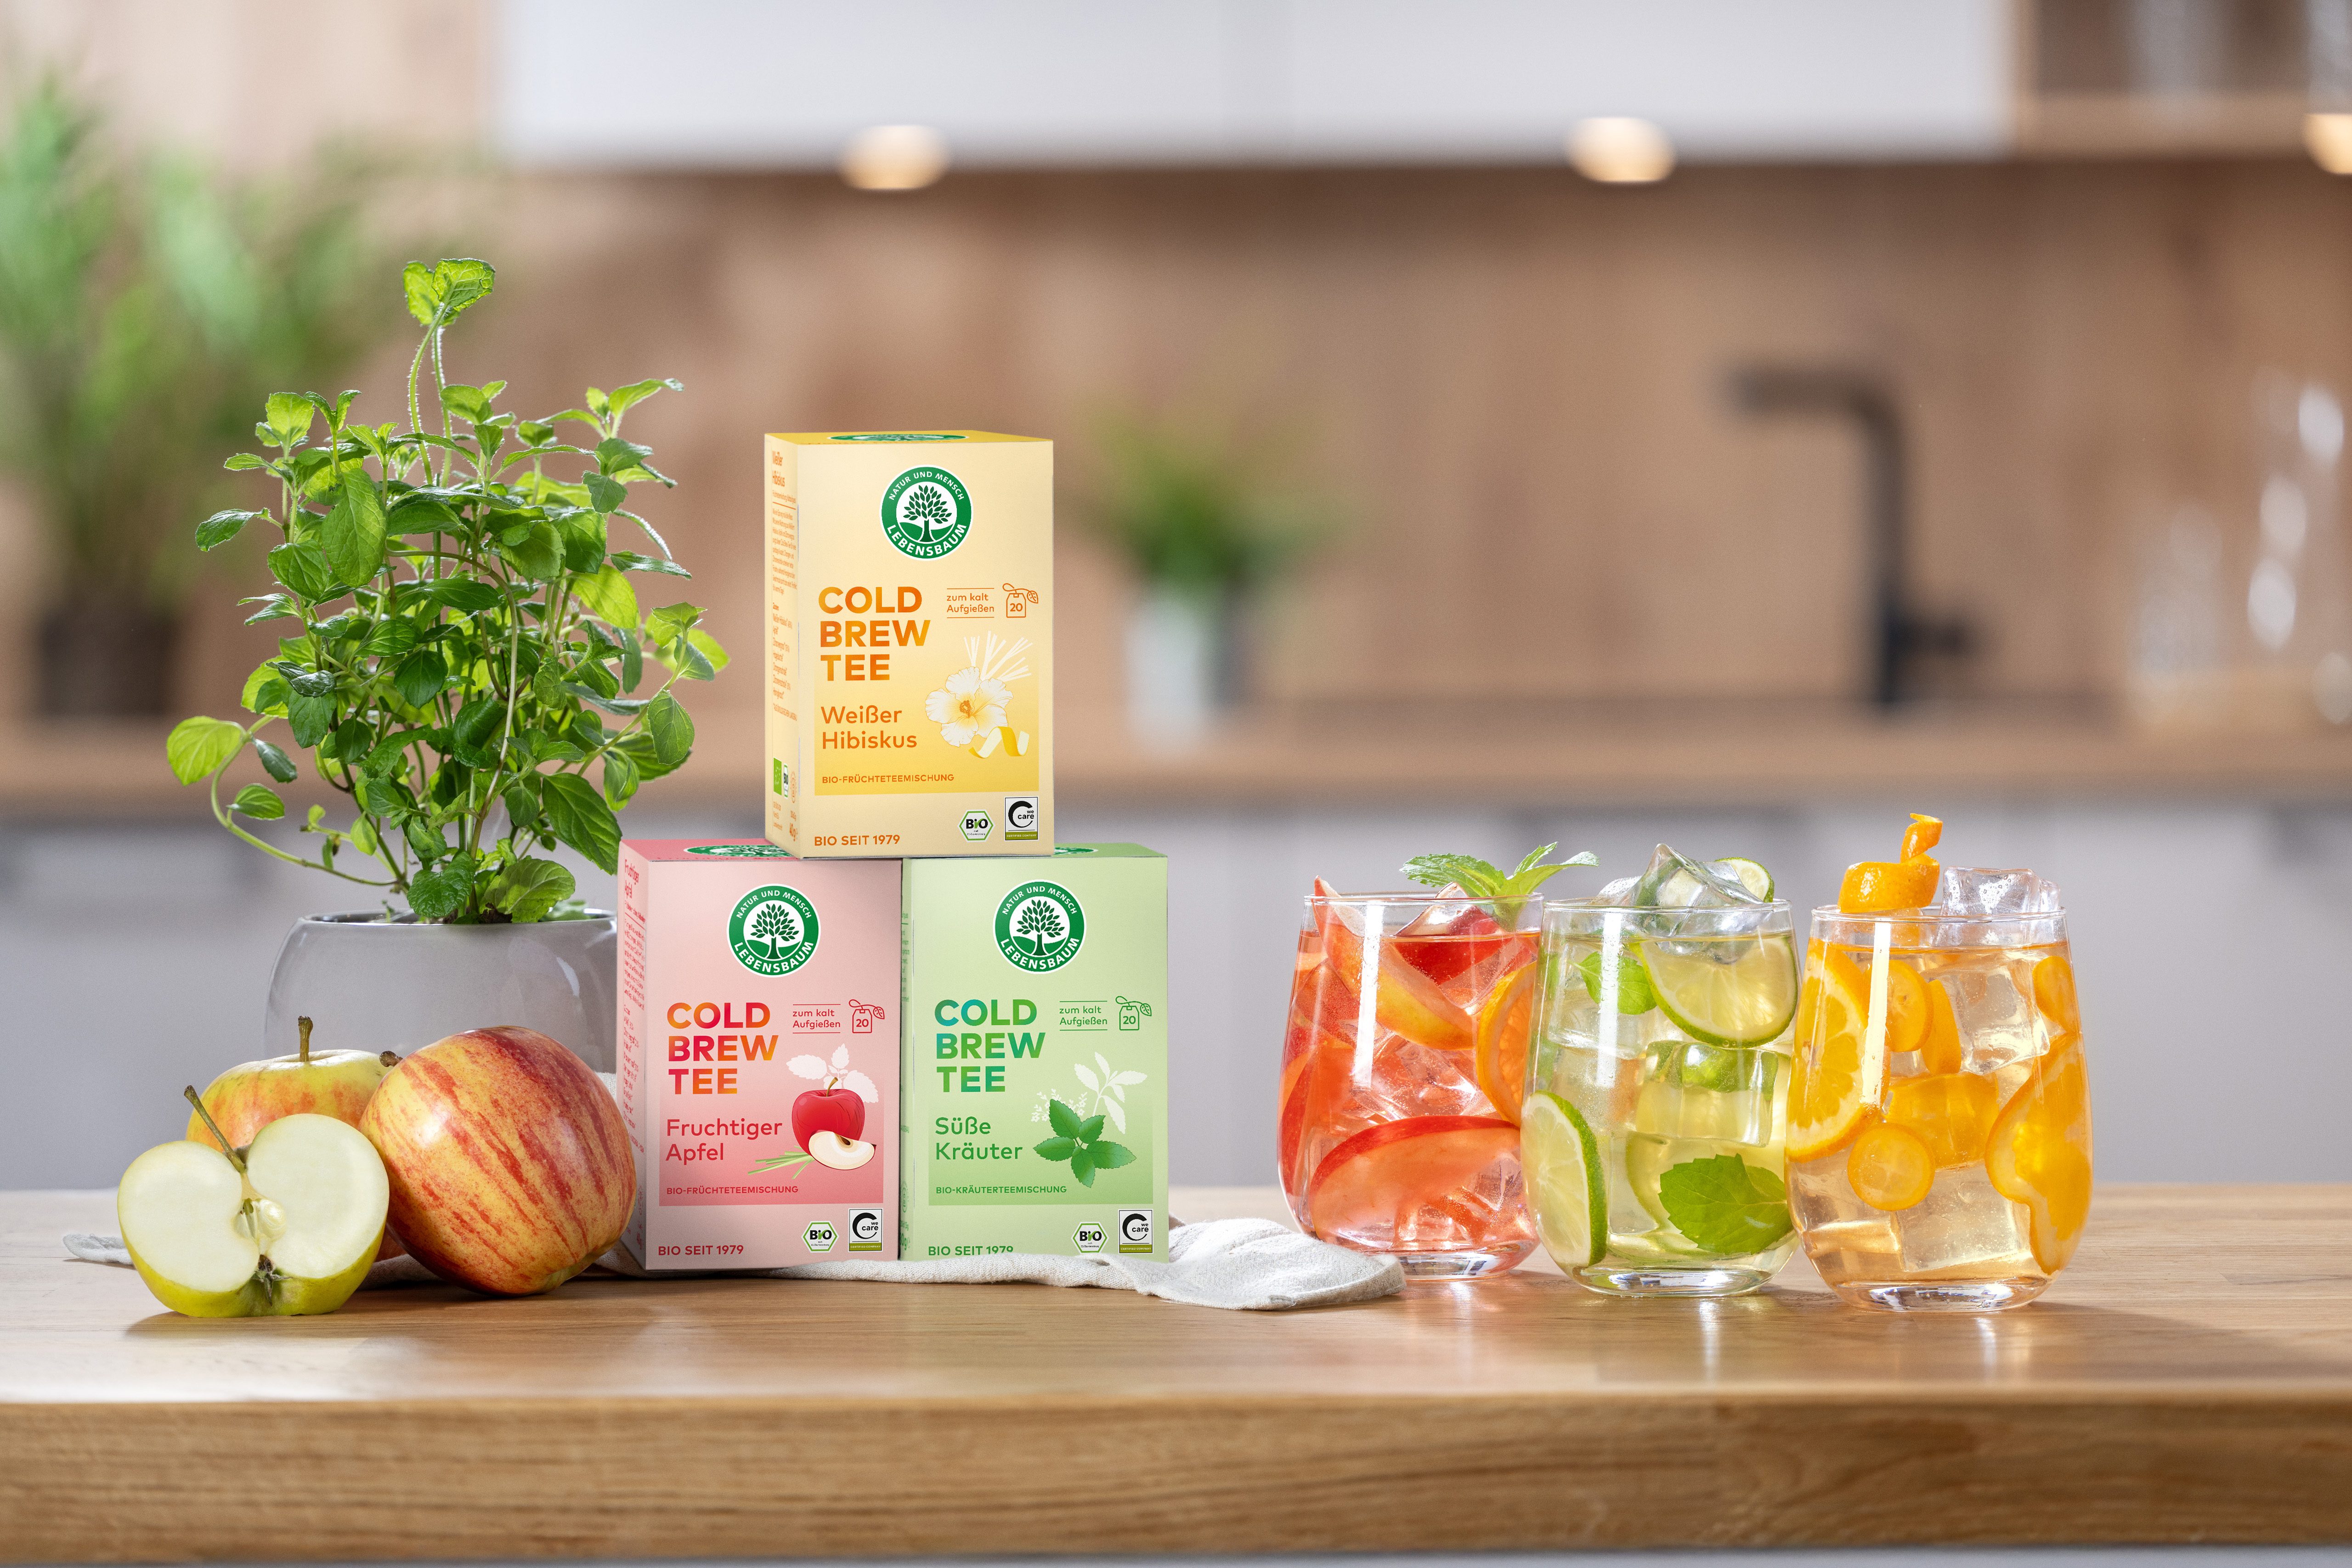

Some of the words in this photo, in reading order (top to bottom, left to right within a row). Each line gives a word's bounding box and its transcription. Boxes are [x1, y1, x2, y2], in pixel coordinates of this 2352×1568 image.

[889, 477, 911, 500] NATUR
[913, 471, 933, 479] UND
[935, 474, 964, 500] MENSCH
[887, 525, 967, 556] LEBENSBAUM
[819, 587, 922, 614] COLD
[970, 592, 989, 601] kalt
[946, 604, 994, 615] Aufgießen
[1010, 603, 1023, 612] 20
[820, 620, 931, 647] BREW
[821, 654, 889, 681] TEE
[820, 705, 903, 724] Weißer
[822, 730, 917, 750] Hibiskus
[822, 774, 955, 784] BIO-FRÜCHTETEEMISCHUNG
[814, 836, 837, 846] BIO
[841, 835, 870, 846] SEIT
[873, 834, 900, 845] 1979
[736, 895, 758, 918] NATUR
[783, 892, 811, 918] MENSCH
[1002, 891, 1024, 914] NATUR
[1048, 888, 1077, 914] MENSCH
[735, 942, 814, 973] LEBENSBAUM
[1001, 938, 1079, 969] LEBENSBAUM
[667, 1003, 770, 1029] COLD
[816, 1009, 835, 1017] kalt
[935, 999, 1037, 1026] COLD
[1083, 1005, 1102, 1014] kalt
[792, 1020, 841, 1030] Aufgießen
[856, 1018, 869, 1027] 20
[1059, 1016, 1108, 1027] Aufgießen
[1123, 1015, 1136, 1025] 20
[669, 1035, 778, 1061] BREW
[937, 1032, 1046, 1059] BREW
[668, 1068, 737, 1094] TEE
[937, 1066, 1005, 1092] TEE
[667, 1118, 782, 1140] Fruchtiger
[935, 1116, 991, 1135] Süße
[666, 1143, 723, 1165] Apfel
[936, 1142, 1023, 1160] Kräuter
[666, 1185, 798, 1195] BIO-FRÜCHTETEEMISCHUNG
[936, 1184, 1067, 1194] BIO-KRÄUTERTEEMISCHUNG
[658, 1246, 681, 1256] BIO
[684, 1245, 713, 1255] SEIT
[716, 1245, 744, 1255] 1979
[928, 1246, 951, 1256] BIO
[955, 1246, 983, 1256] SEIT
[986, 1246, 1013, 1254] 1979
